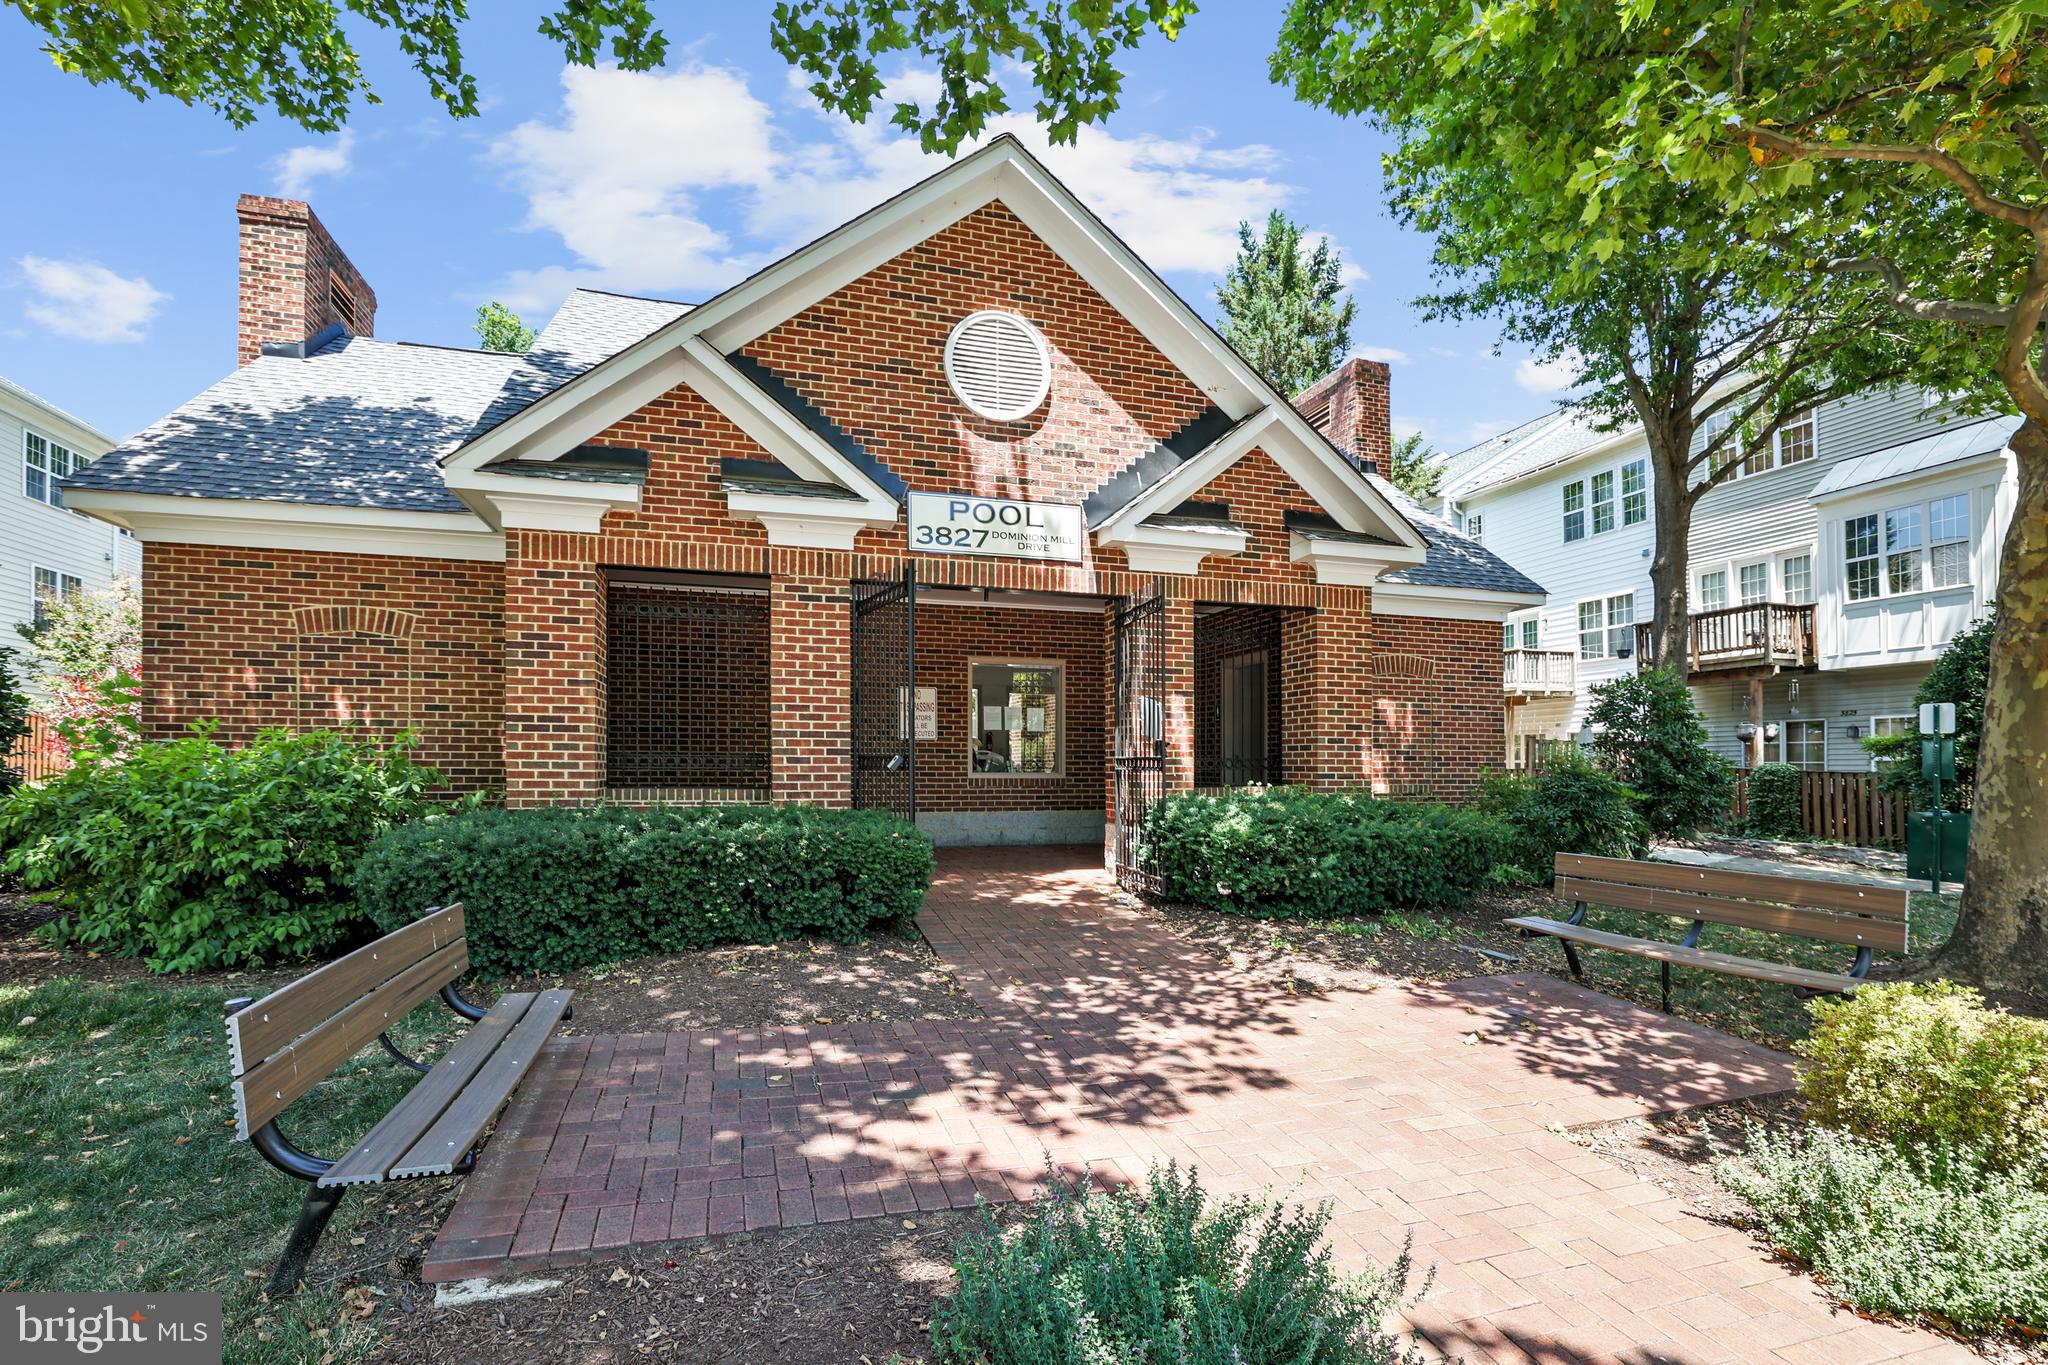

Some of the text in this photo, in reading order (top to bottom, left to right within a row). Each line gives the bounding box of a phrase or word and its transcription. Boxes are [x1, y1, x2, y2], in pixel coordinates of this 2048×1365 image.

[949, 501, 1044, 528] POOL
[916, 525, 1076, 548] 3827 DOMINION MILL
[1017, 542, 1051, 552] DRIVE
